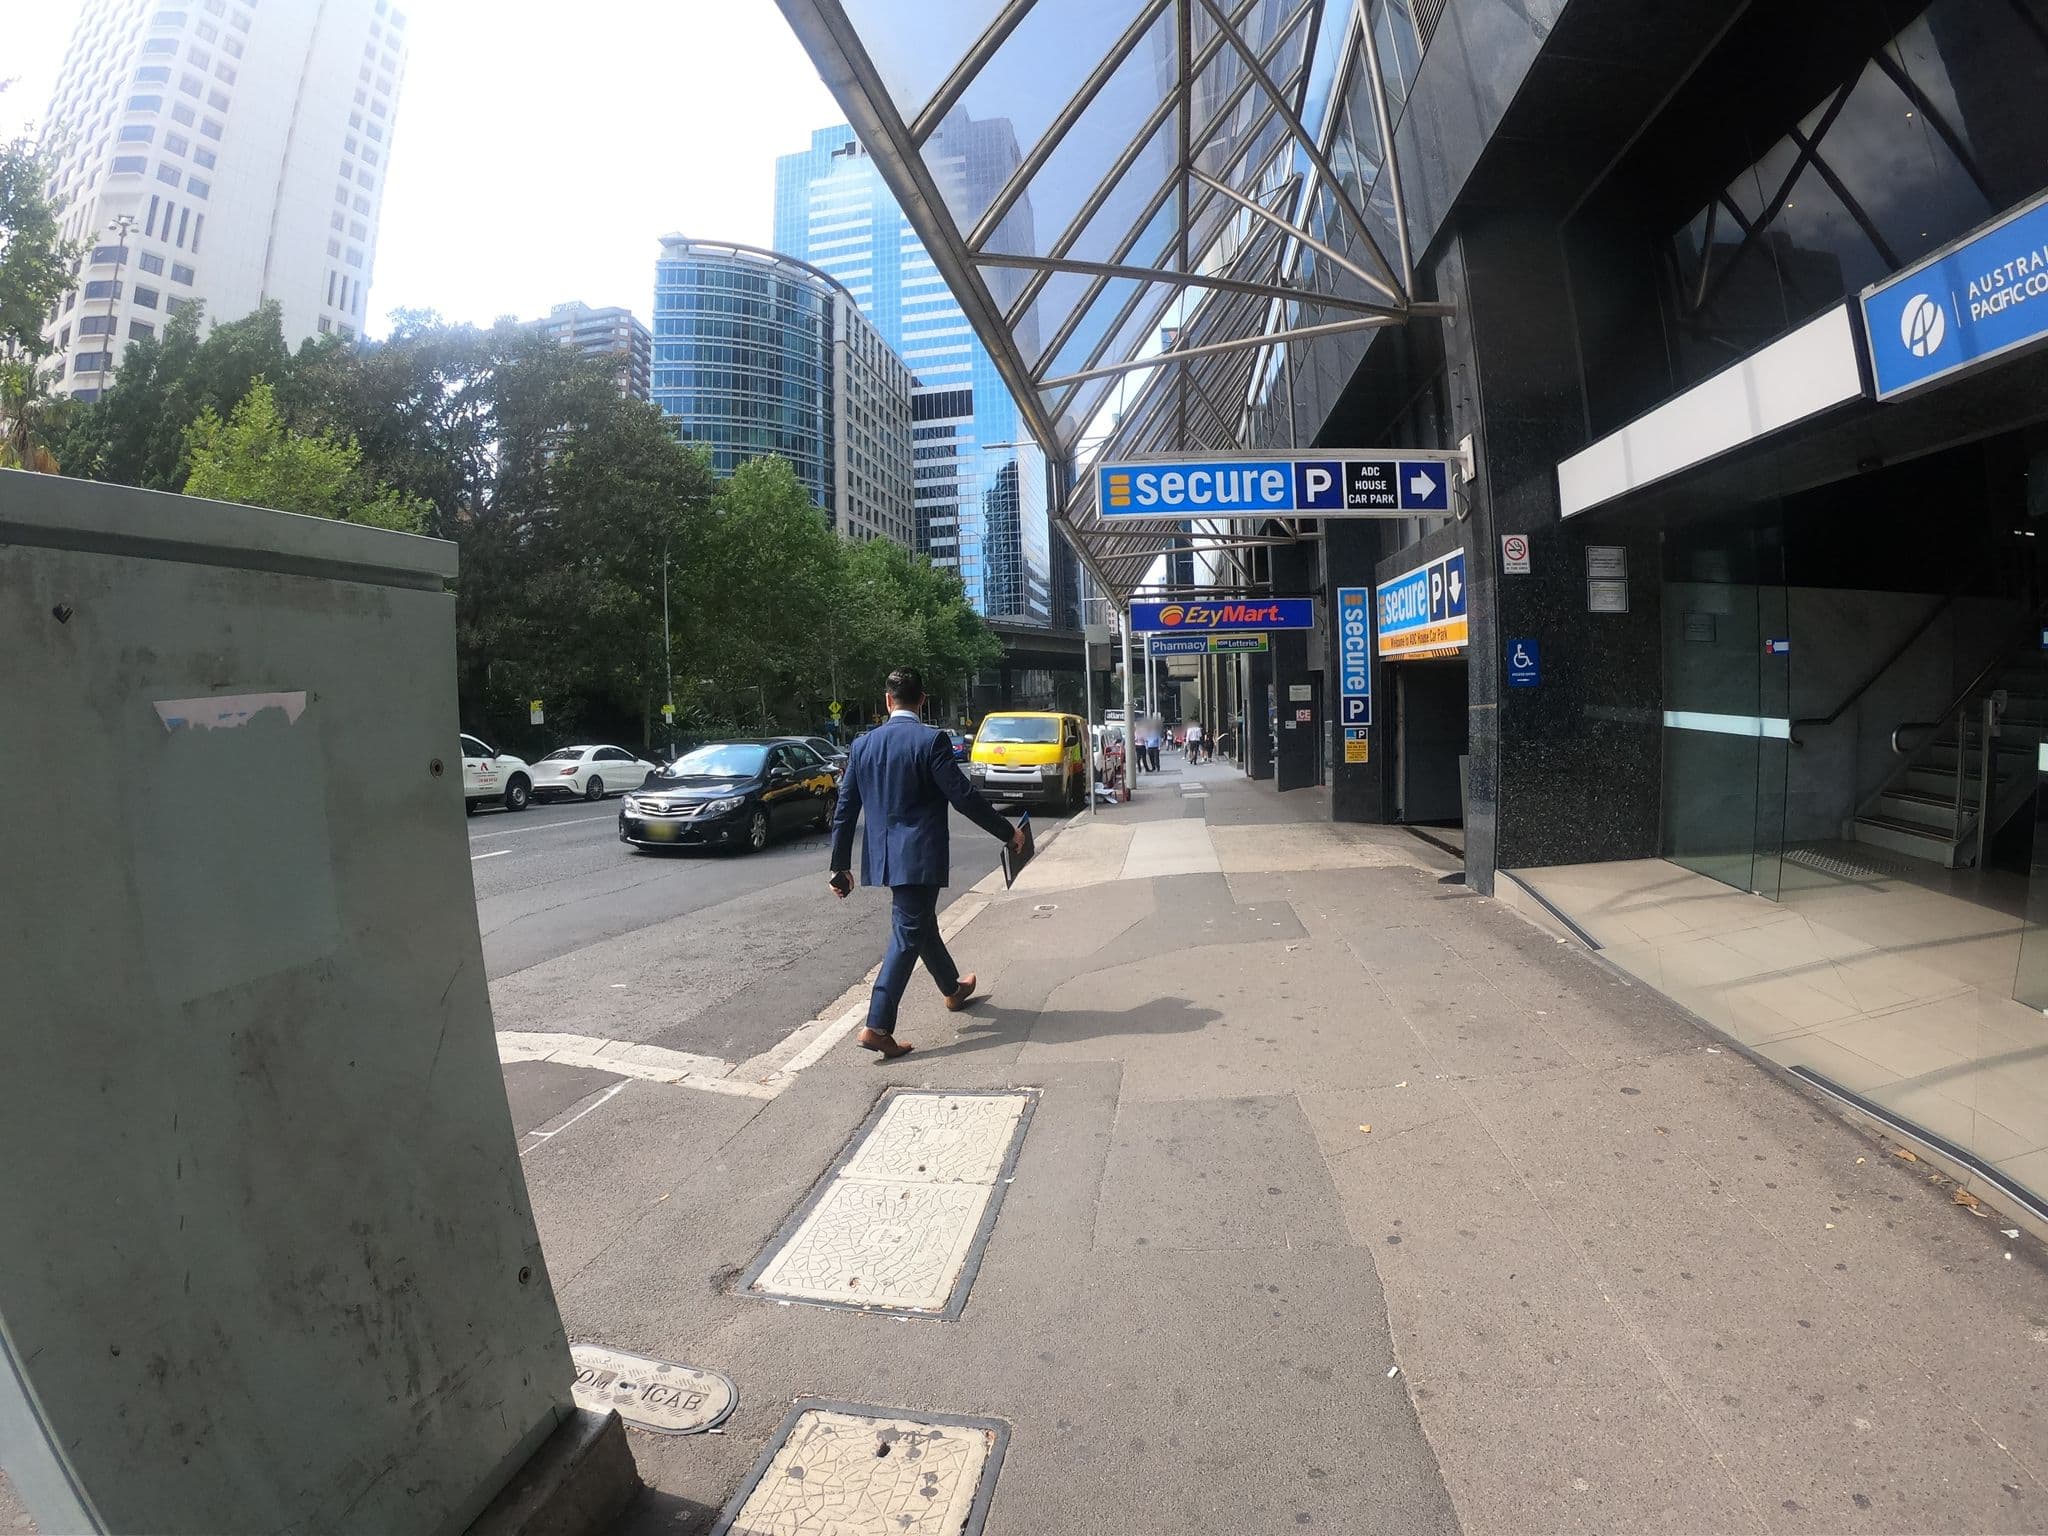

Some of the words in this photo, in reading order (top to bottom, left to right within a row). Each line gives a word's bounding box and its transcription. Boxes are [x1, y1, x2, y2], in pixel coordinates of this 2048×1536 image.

[1970, 283, 2026, 322] PACIFIC
[2025, 270, 2048, 296] CO
[1360, 466, 1381, 477] ADC
[1135, 469, 1285, 507] secure
[1305, 468, 1332, 503] P
[1355, 480, 1387, 490] HOUSE
[1348, 494, 1368, 504] CAR
[1370, 494, 1395, 504] PARK
[1385, 579, 1426, 625] secure
[1431, 572, 1442, 614] P
[1184, 604, 1280, 627] EzyMart
[1152, 640, 1207, 651] Pharmacy
[1228, 639, 1259, 648] Lotteries
[1345, 608, 1365, 690] secure
[1106, 711, 1125, 719] atlant
[1349, 700, 1364, 720] P
[1358, 730, 1366, 739] P
